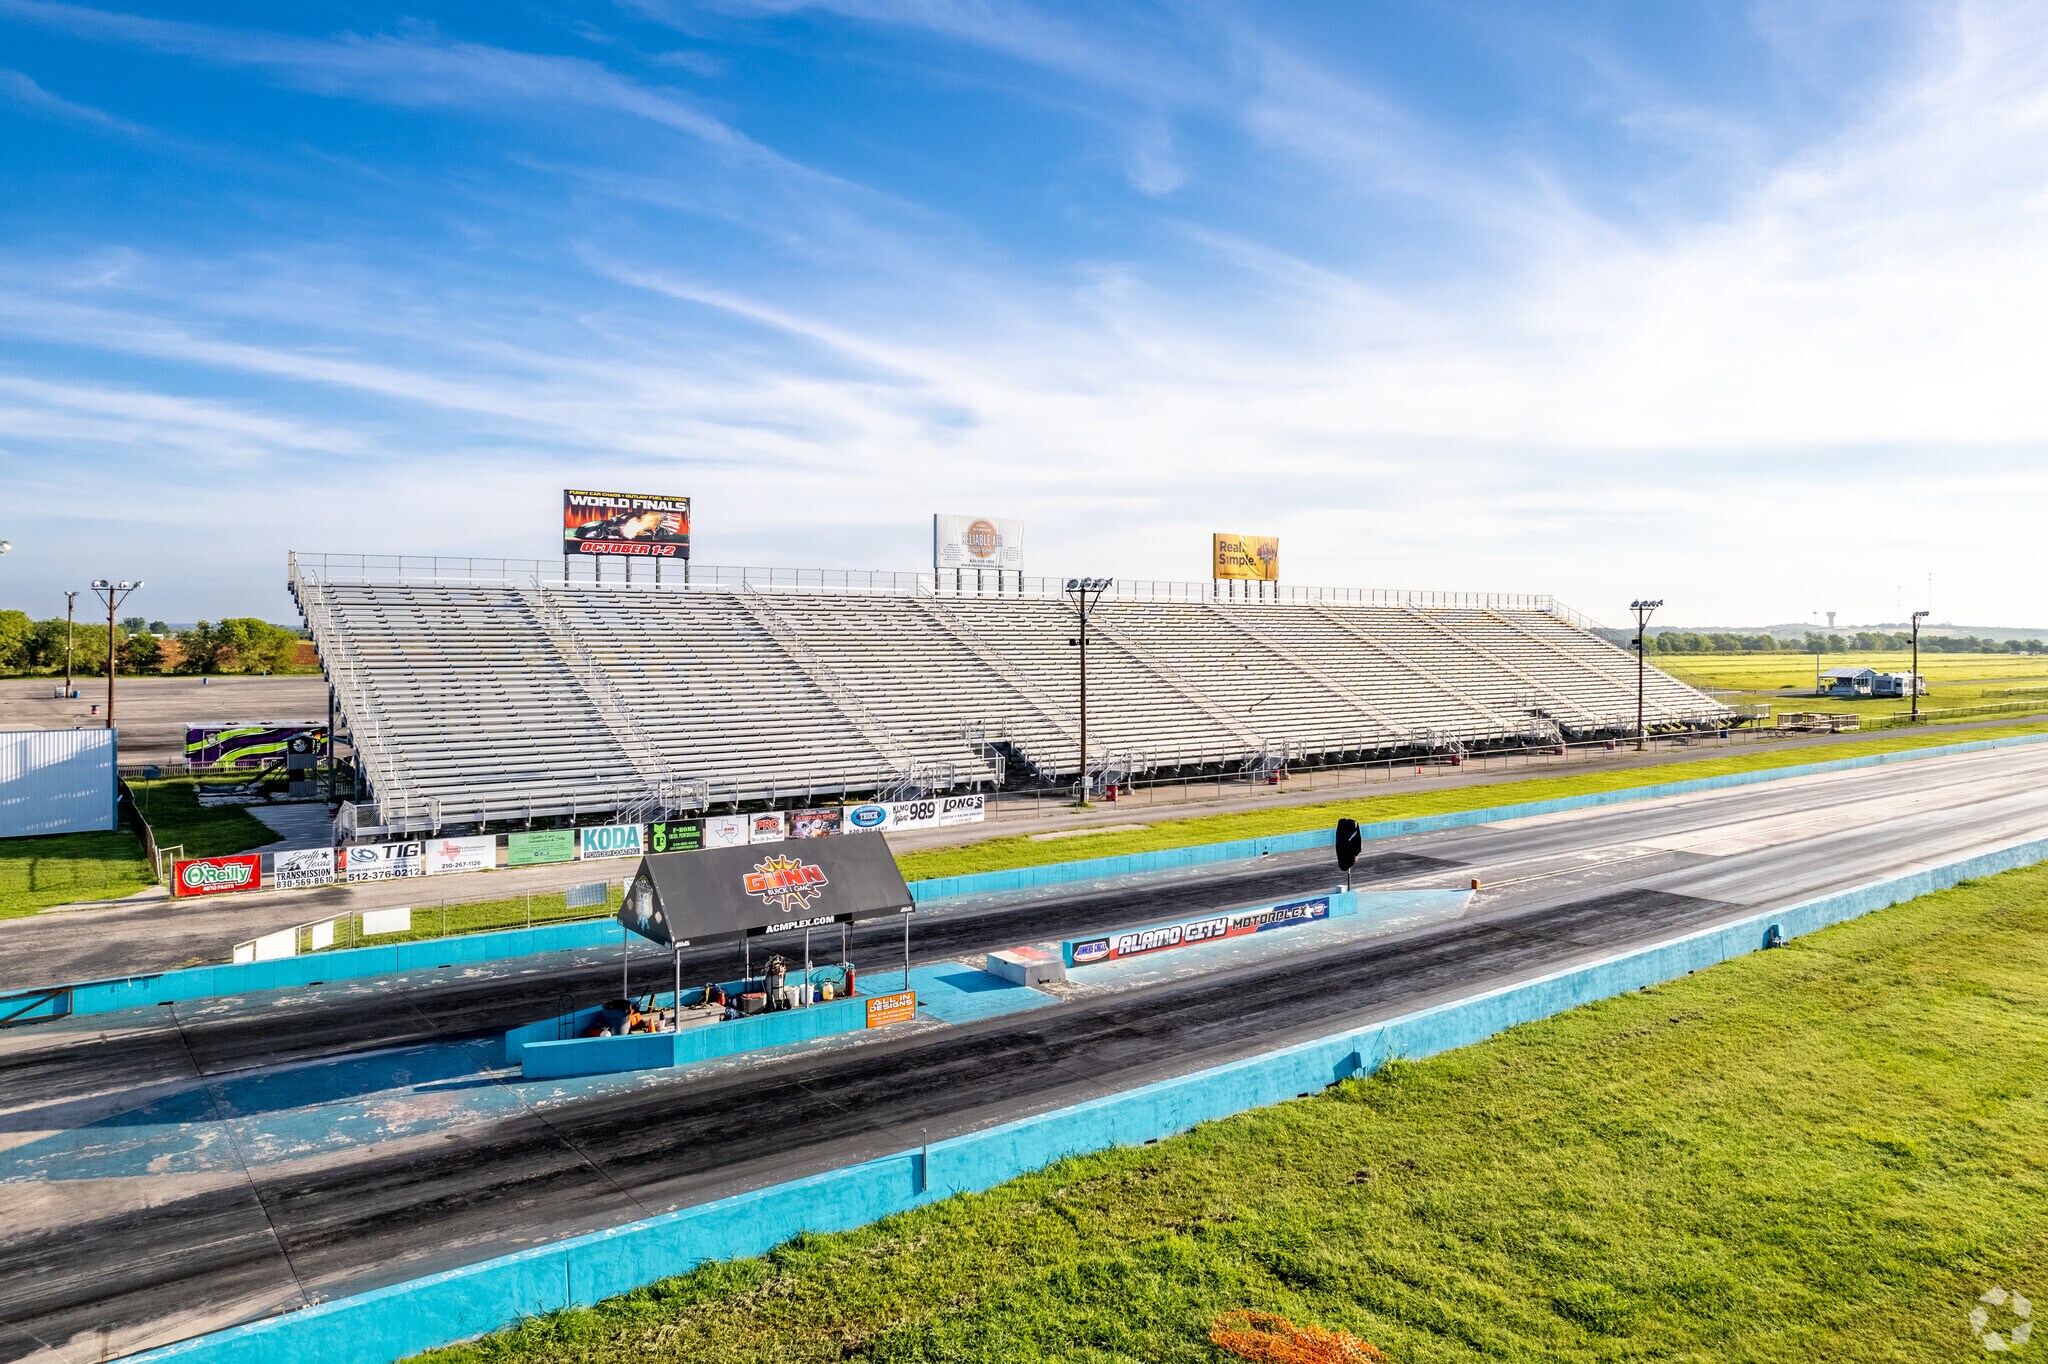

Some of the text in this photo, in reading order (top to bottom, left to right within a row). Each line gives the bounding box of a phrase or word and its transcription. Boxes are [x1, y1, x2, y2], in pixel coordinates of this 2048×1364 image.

[569, 495, 686, 512] WORLD FINALS
[961, 532, 1003, 547] RELIABLE AIR
[580, 542, 675, 556] OCTOBER 1-2
[893, 804, 909, 814] KLMO
[910, 801, 935, 821] 98.9
[943, 796, 983, 813] LONG'S
[859, 810, 878, 821] TRUCK
[756, 819, 780, 832] PRO
[583, 826, 640, 852] KODA
[656, 836, 664, 846] F
[288, 851, 319, 862] South
[382, 843, 419, 859] TIG
[585, 850, 612, 858] POWDER
[305, 860, 331, 869] Texas
[441, 860, 481, 869] 210-267-1126
[186, 864, 250, 885] O'Reilly
[276, 868, 331, 881] TRANSMISSION
[348, 867, 420, 881] 512-376-0212
[746, 866, 825, 893] GUNN
[276, 876, 333, 889] 830-569-8610
[768, 887, 788, 896] BUICK
[765, 915, 835, 934] ACMPLEX.COM
[1232, 905, 1307, 930] MOTORPLEX
[1118, 917, 1229, 956] ALAMO CITY
[869, 998, 913, 1013] DESIGNS
[873, 993, 911, 1006] ALL IN
